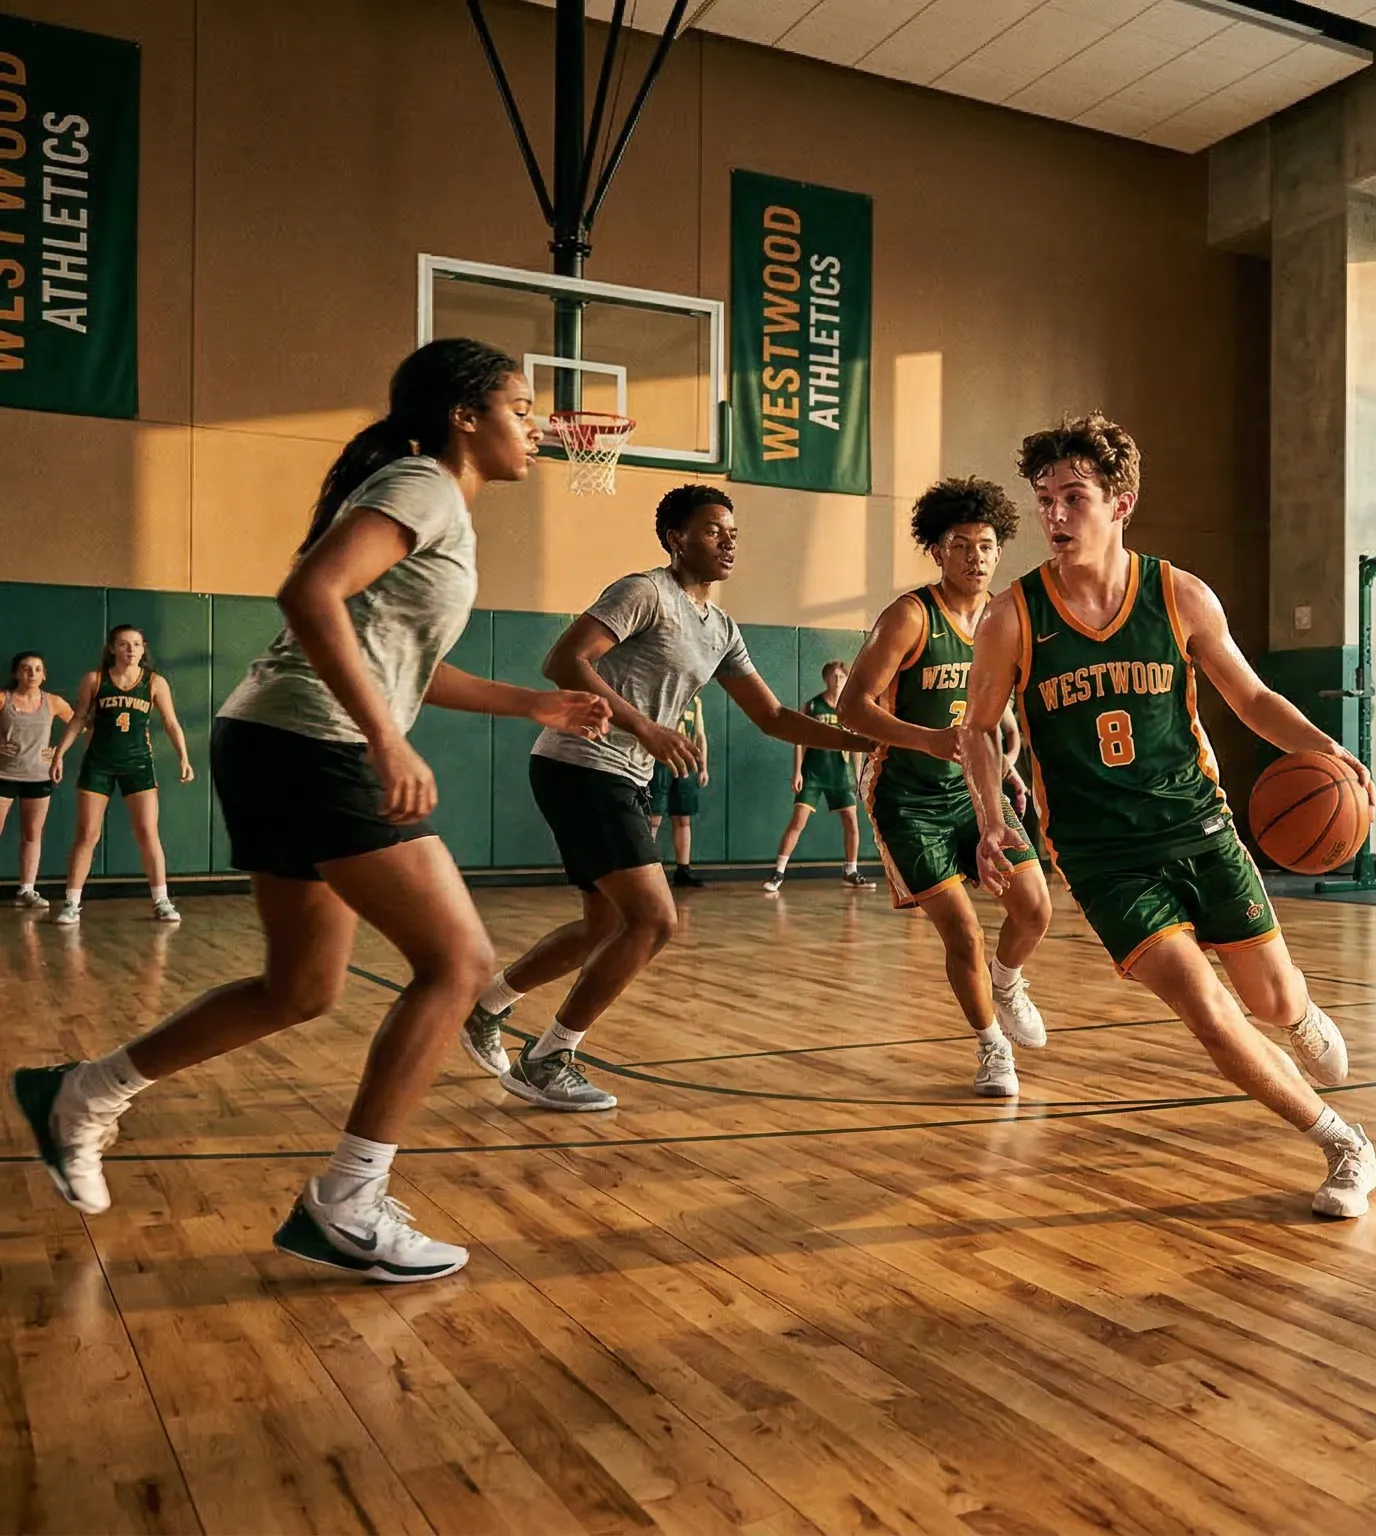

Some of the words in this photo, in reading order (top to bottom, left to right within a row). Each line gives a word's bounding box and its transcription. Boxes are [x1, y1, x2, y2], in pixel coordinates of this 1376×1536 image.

[42, 111, 90, 334] ATHLETICS
[762, 204, 801, 461] WESTWOOD
[809, 254, 841, 430] ATHLETICS
[922, 662, 972, 690] WEST
[1038, 661, 1174, 712] WESTWOOD
[115, 712, 130, 732] 4
[1096, 709, 1136, 768] 8
